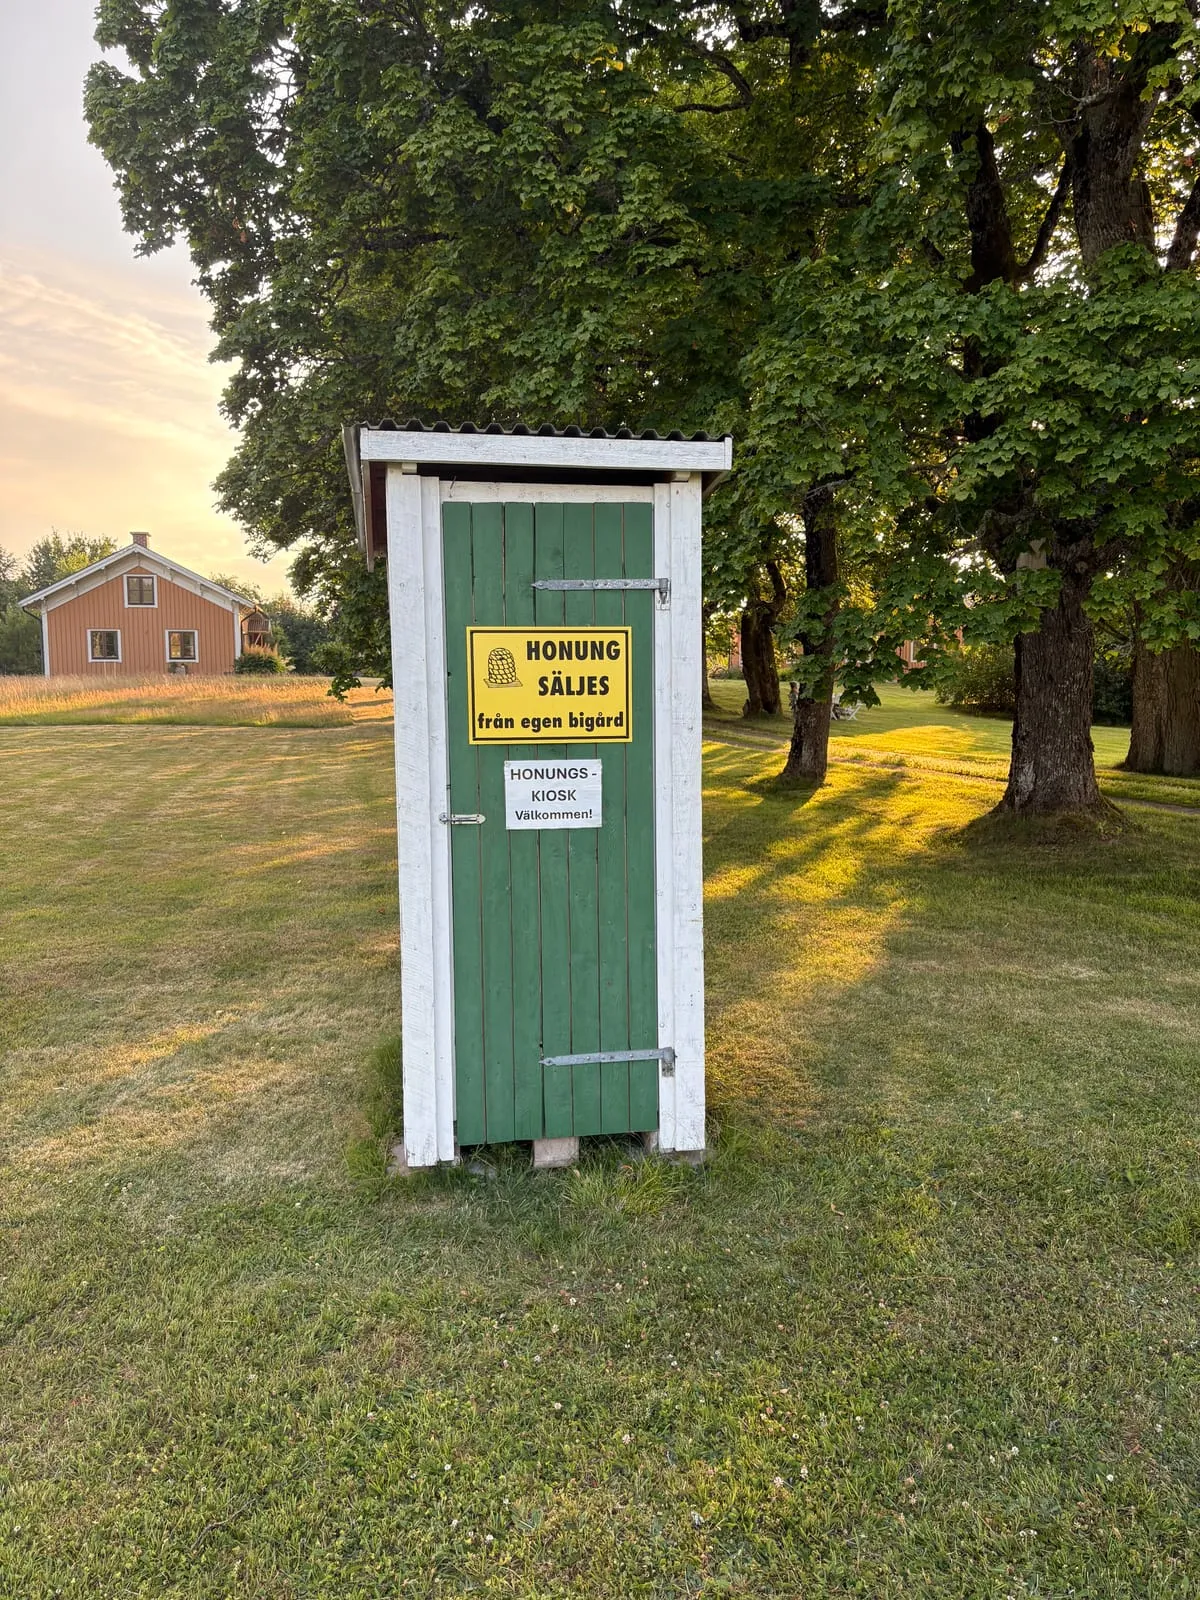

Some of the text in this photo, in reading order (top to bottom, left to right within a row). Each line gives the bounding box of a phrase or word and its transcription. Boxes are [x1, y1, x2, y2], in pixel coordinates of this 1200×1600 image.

[526, 640, 621, 661] HONUNG
[538, 670, 610, 696] SÄLJES
[477, 711, 624, 733] från egen bigård
[531, 789, 577, 802] KIOSK
[515, 809, 593, 821] Välkommen!
